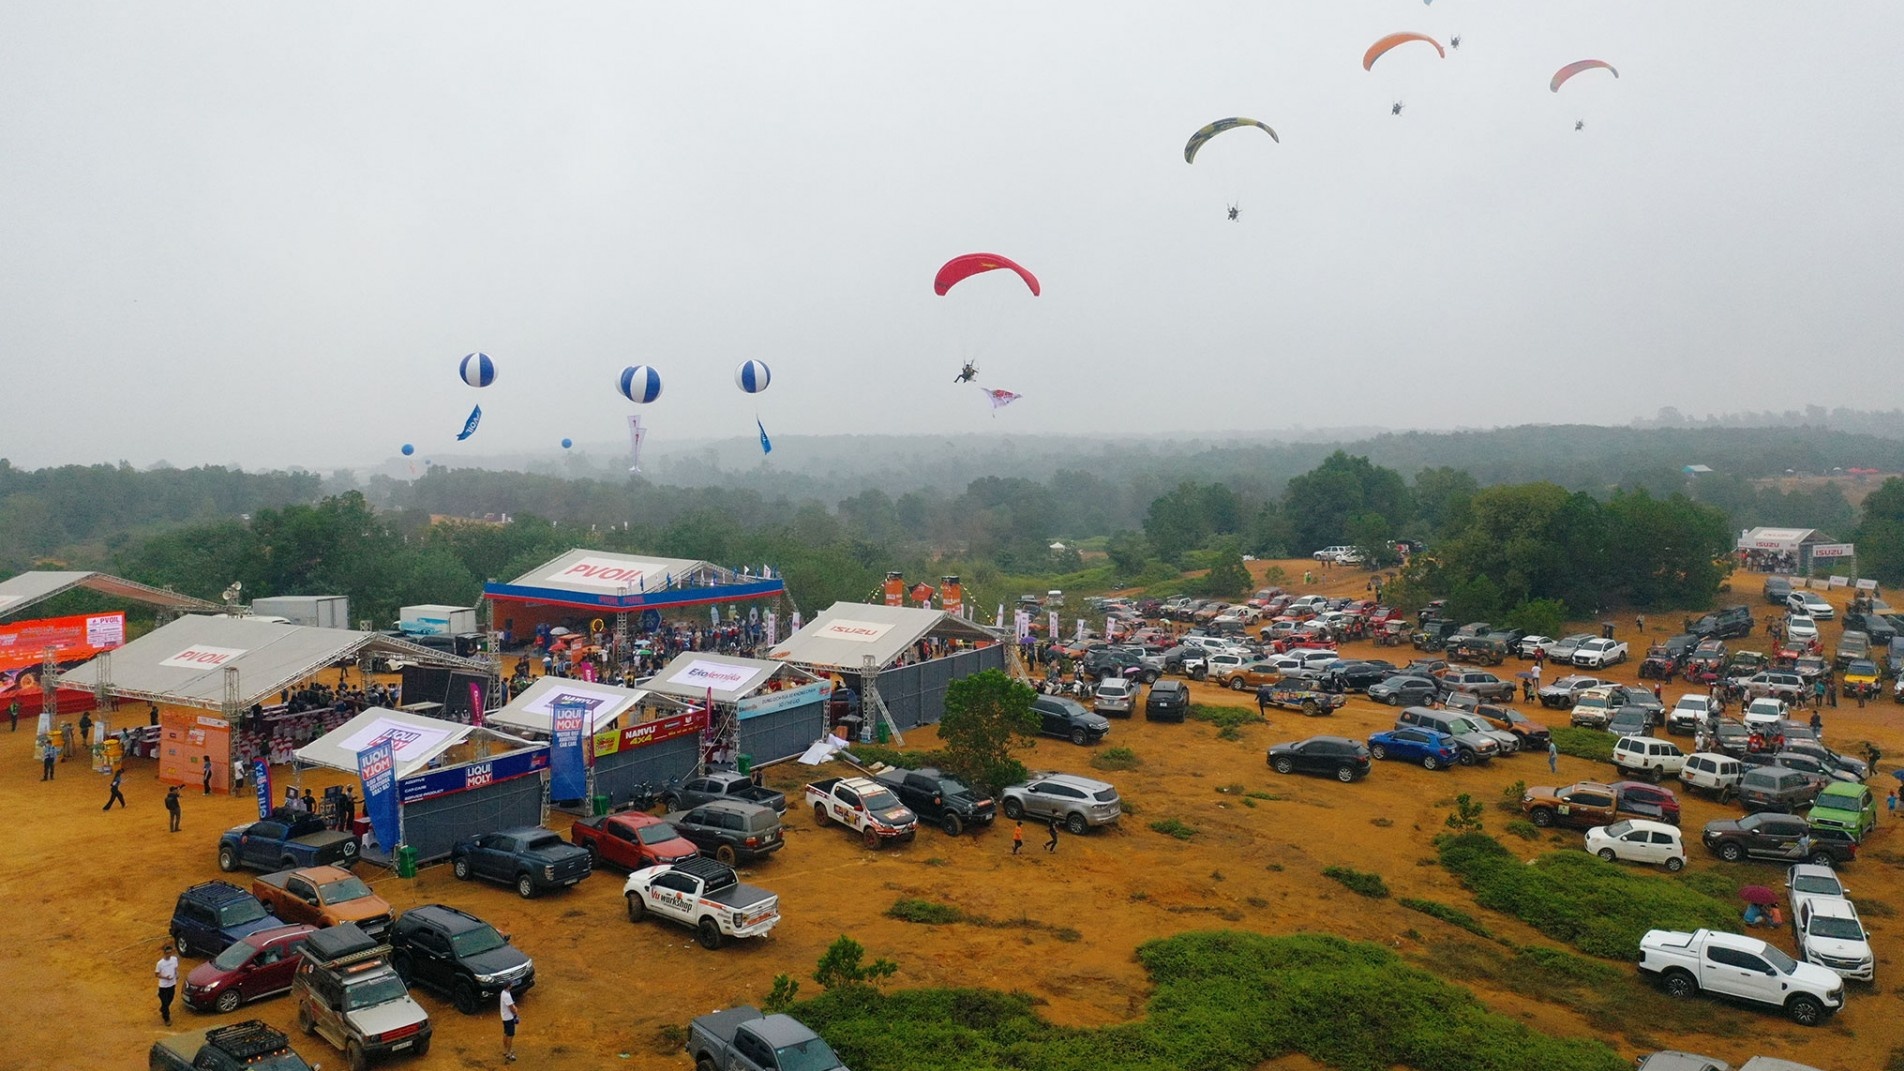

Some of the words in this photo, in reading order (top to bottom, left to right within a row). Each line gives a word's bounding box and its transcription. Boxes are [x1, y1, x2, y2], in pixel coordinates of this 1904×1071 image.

[1755, 541, 1780, 549] ISUZU
[1815, 549, 1844, 557] ISUZU
[564, 564, 643, 582] PVOIL
[100, 616, 120, 624] PVOIL
[830, 625, 878, 636] ISUZU
[174, 650, 230, 665] PVOIL
[557, 709, 582, 720] LIQUI
[557, 719, 582, 730] MOLY
[467, 764, 491, 776] LIQUI
[467, 774, 492, 787] MOLY
[661, 895, 693, 913] workshop
